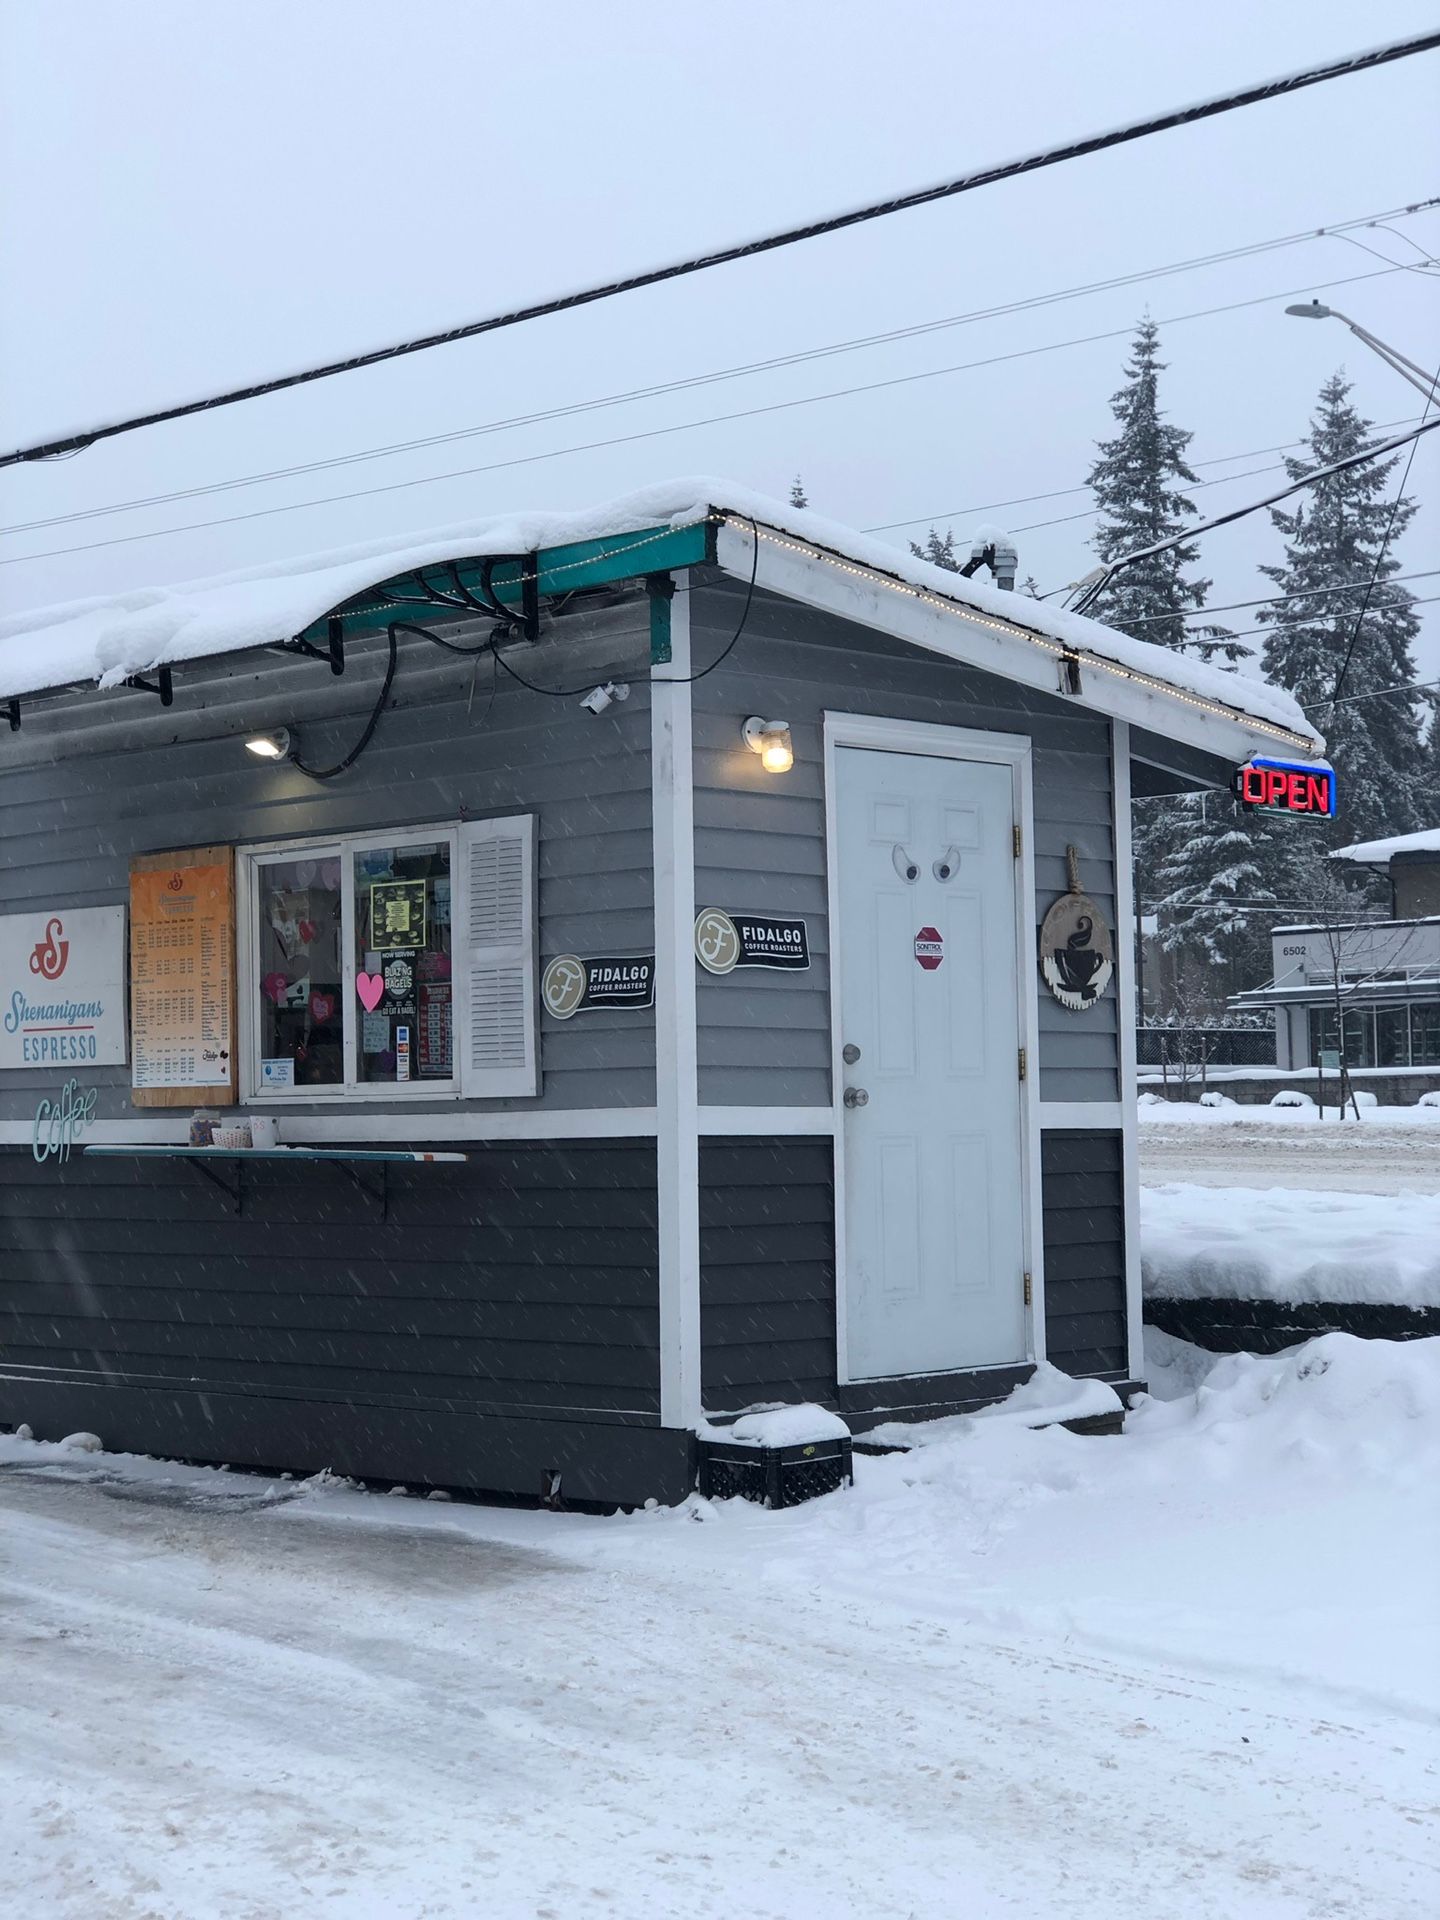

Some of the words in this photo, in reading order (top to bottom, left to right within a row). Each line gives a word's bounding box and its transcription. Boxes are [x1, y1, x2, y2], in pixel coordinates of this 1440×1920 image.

[1243, 768, 1329, 813] OPEN
[742, 926, 801, 943] FIDALGO
[744, 942, 769, 951] COFFEE
[770, 944, 803, 952] ROASTERS
[1283, 946, 1306, 956] 6502
[590, 966, 649, 982] FIDALGO
[384, 979, 412, 989] BAGELS
[614, 982, 647, 990] ROASTERS
[5, 991, 104, 1034] Shenanigans
[23, 1035, 97, 1061] ESPRESSO
[32, 1077, 98, 1164] Coffee
